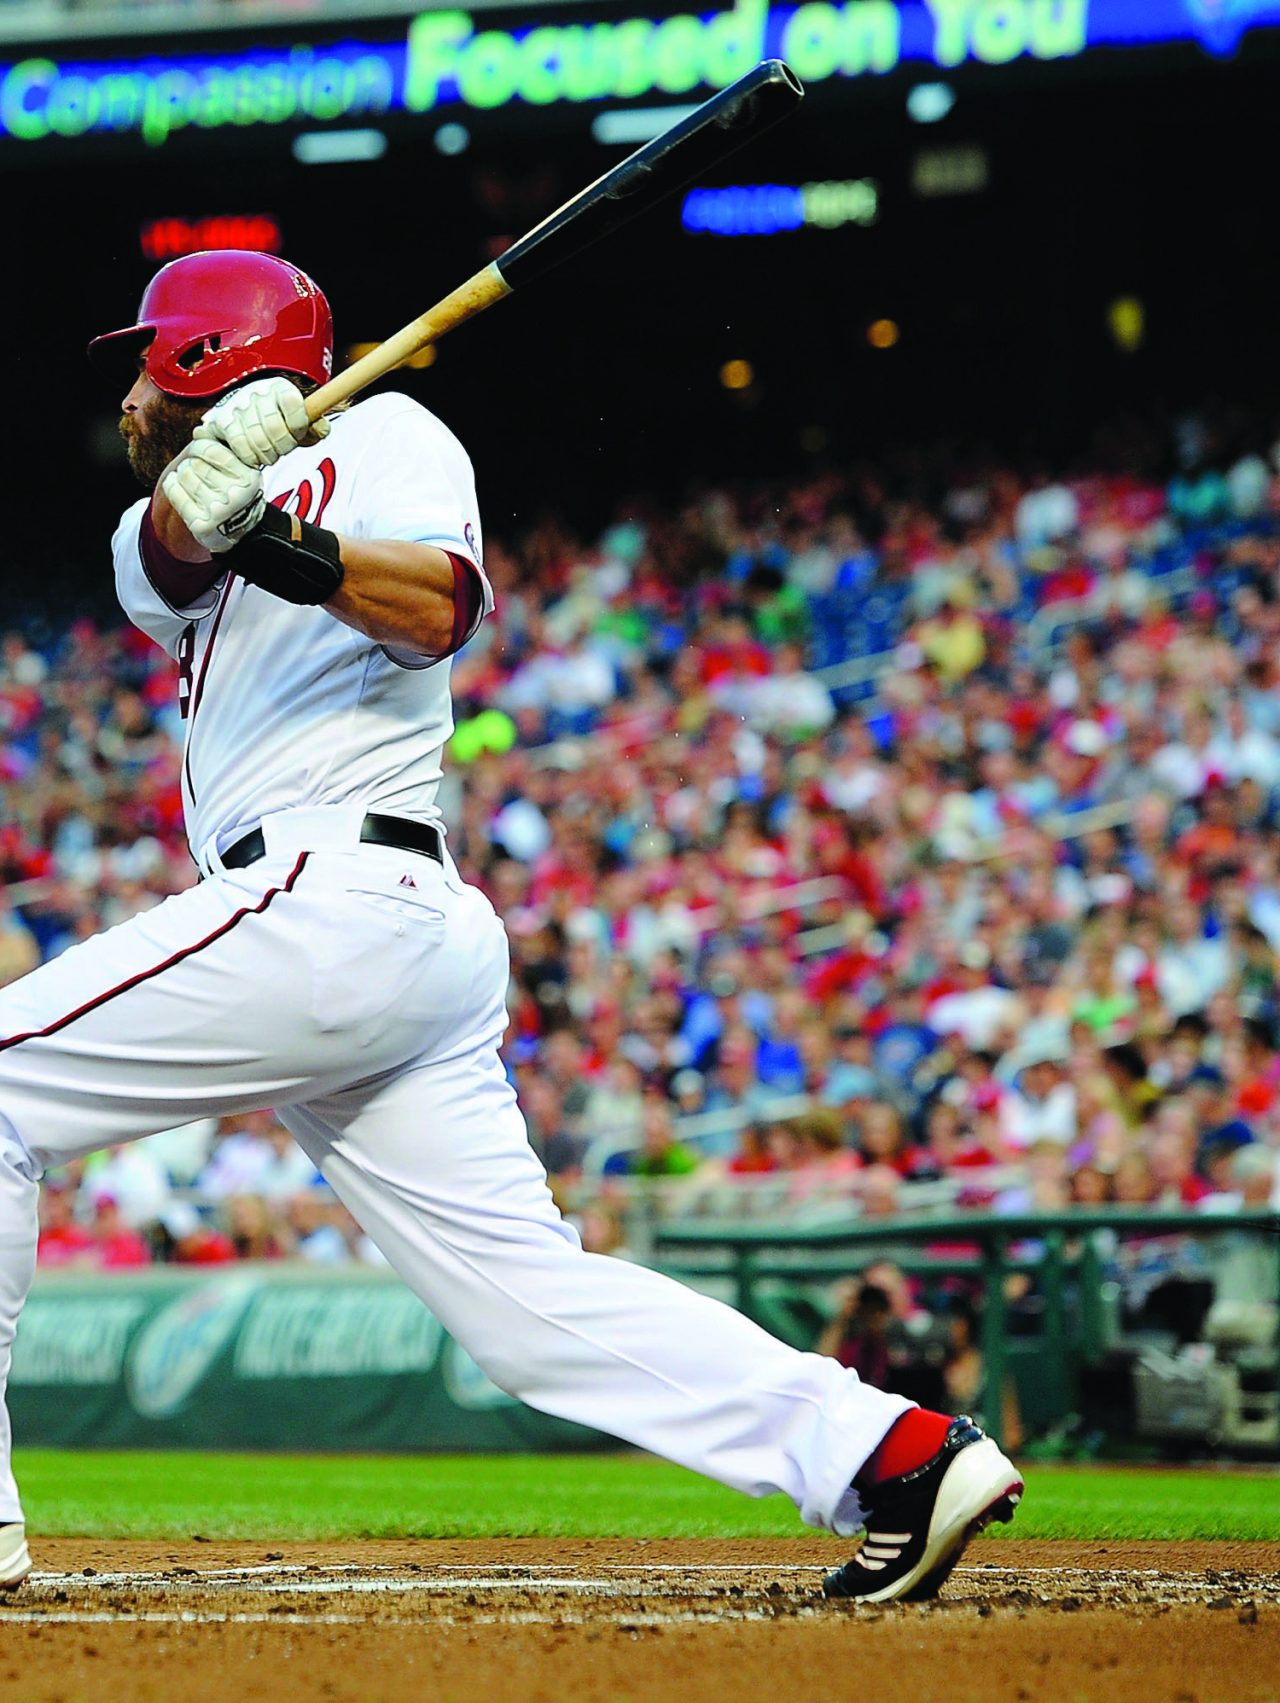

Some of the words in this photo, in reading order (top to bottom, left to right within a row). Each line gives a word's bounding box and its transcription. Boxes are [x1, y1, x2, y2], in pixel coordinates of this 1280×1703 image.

[0, 43, 393, 146] Compassion
[405, 0, 768, 112] Focused
[782, 0, 901, 82] on
[926, 0, 1087, 67] You
